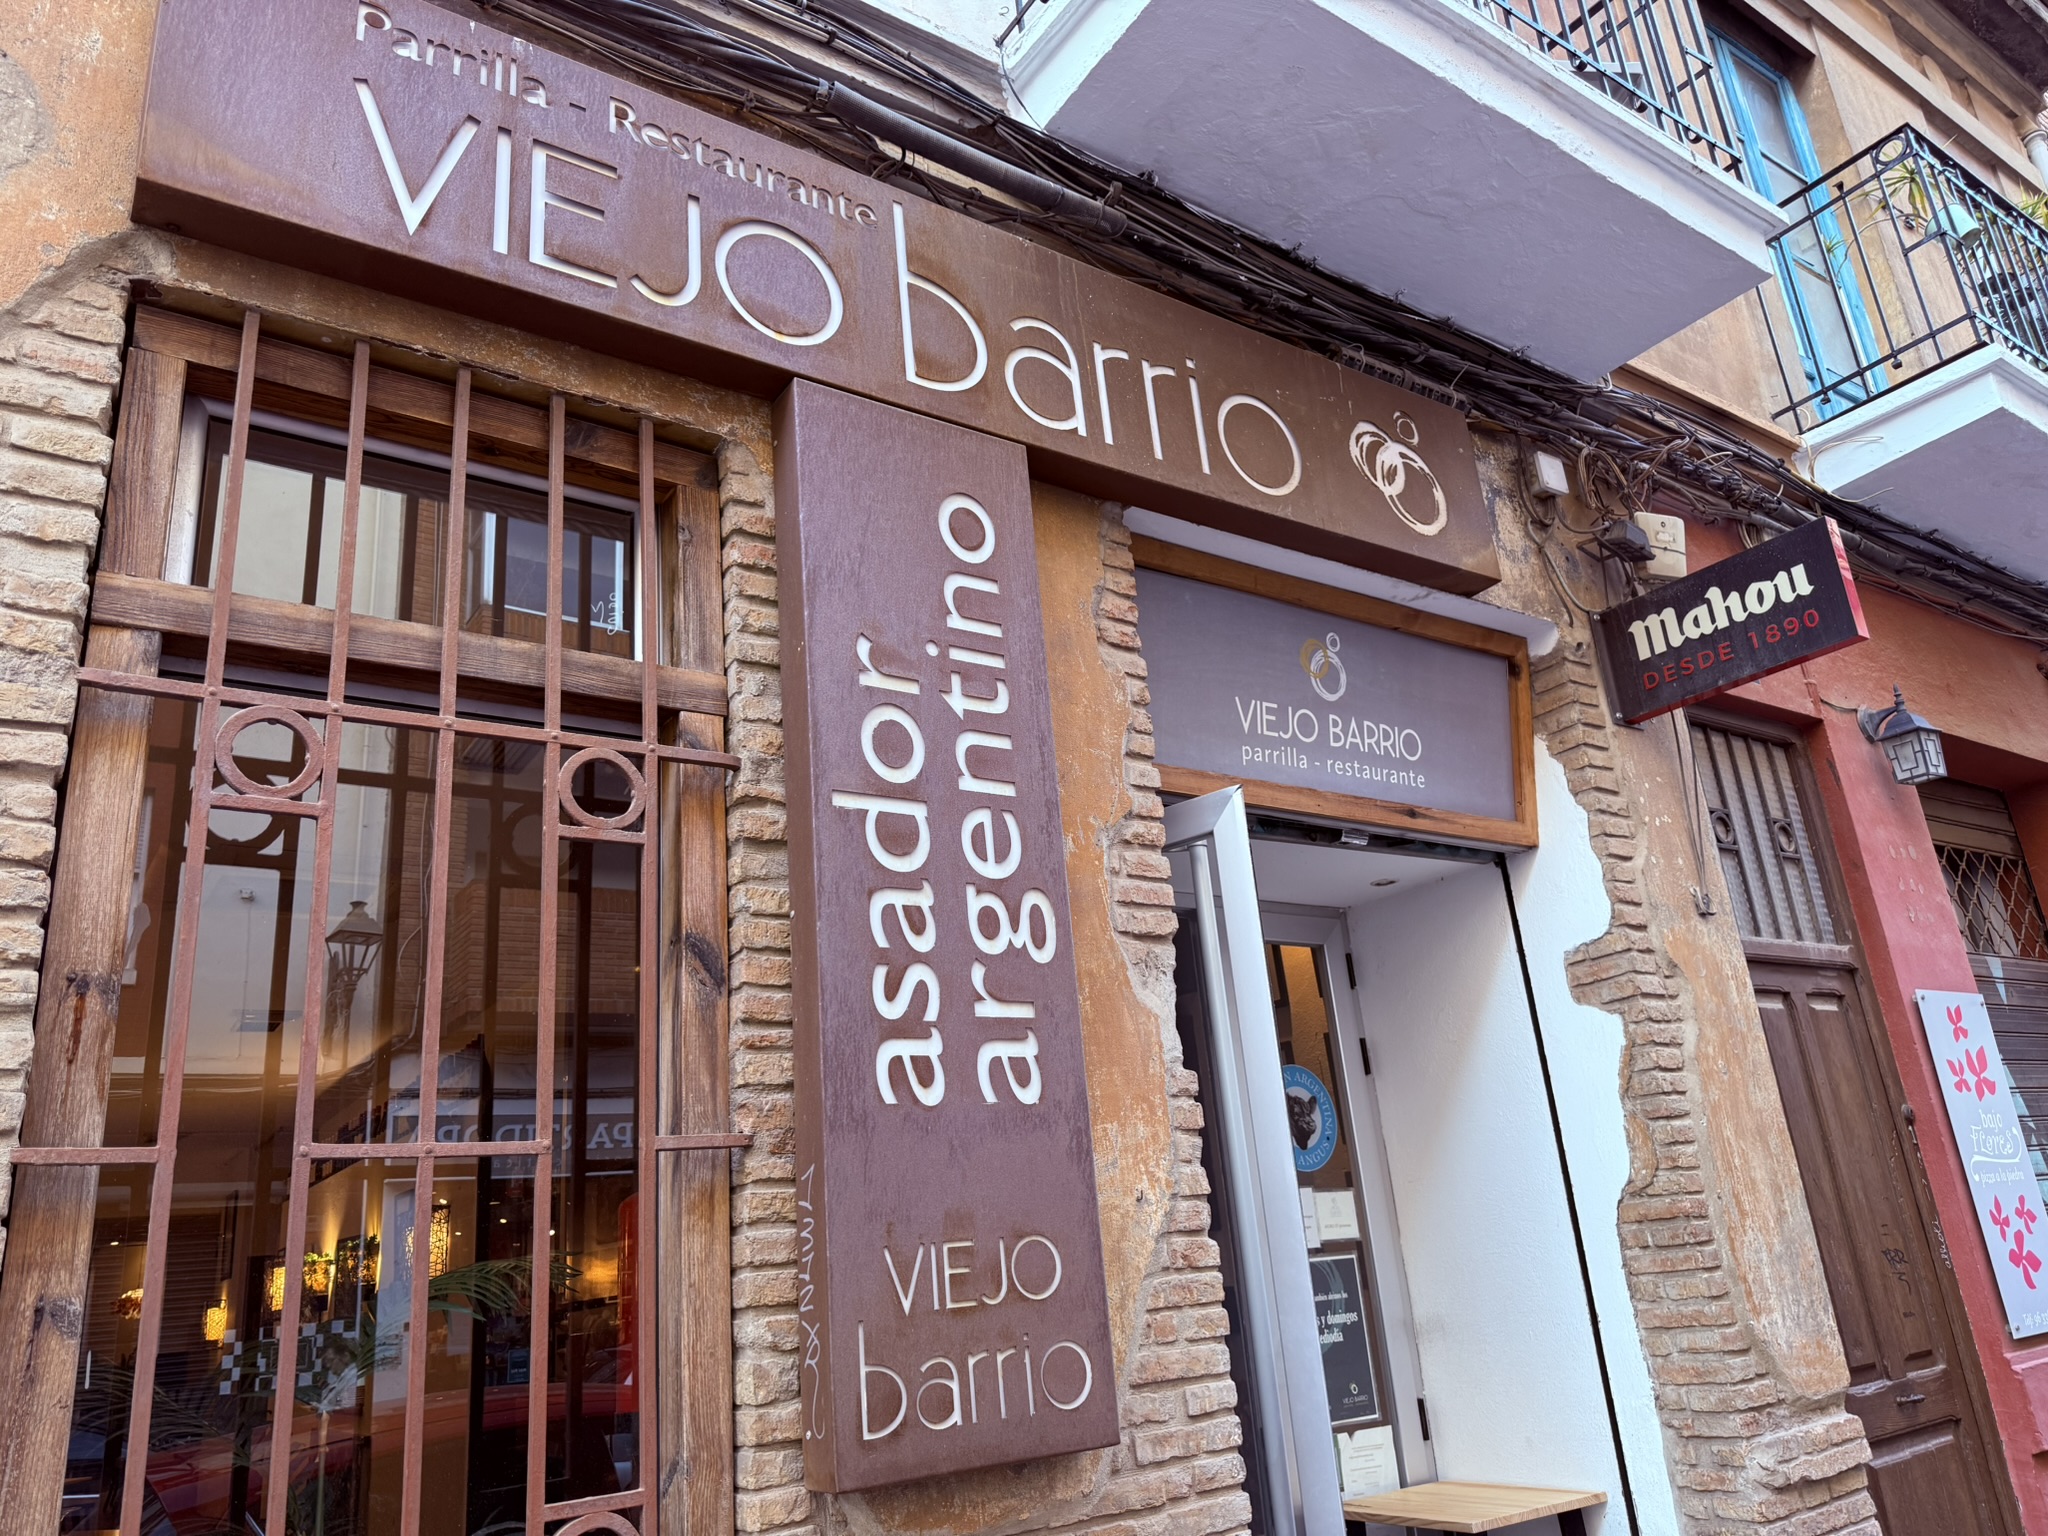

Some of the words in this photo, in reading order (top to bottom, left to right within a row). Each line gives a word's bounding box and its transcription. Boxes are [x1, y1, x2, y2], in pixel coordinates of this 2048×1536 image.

[355, 1, 552, 109] Parrilla
[608, 96, 879, 230] Restaurante
[353, 78, 844, 346] VIEJO
[892, 202, 1302, 496] barrio
[1628, 563, 1815, 662] Mahou
[1643, 642, 1735, 690] DESDE
[1748, 609, 1820, 649] 1890
[1235, 696, 1319, 743] VIEJO
[1329, 714, 1422, 761] BARRIO
[926, 492, 1057, 1105] argentino
[1242, 745, 1308, 768] parrilla
[1327, 757, 1425, 788] restaurante
[832, 633, 946, 1107] asador
[1294, 1071, 1333, 1135] ARGENTINA
[1979, 1109, 2003, 1133] bajo
[1298, 1142, 1330, 1166] ANGUS
[1980, 1170, 1996, 1188] pizza
[883, 1234, 1062, 1316] VIEJO
[1319, 1327, 1344, 1344] ediodía
[1327, 1310, 1359, 1325] domingos
[858, 1320, 1093, 1441] barrio
